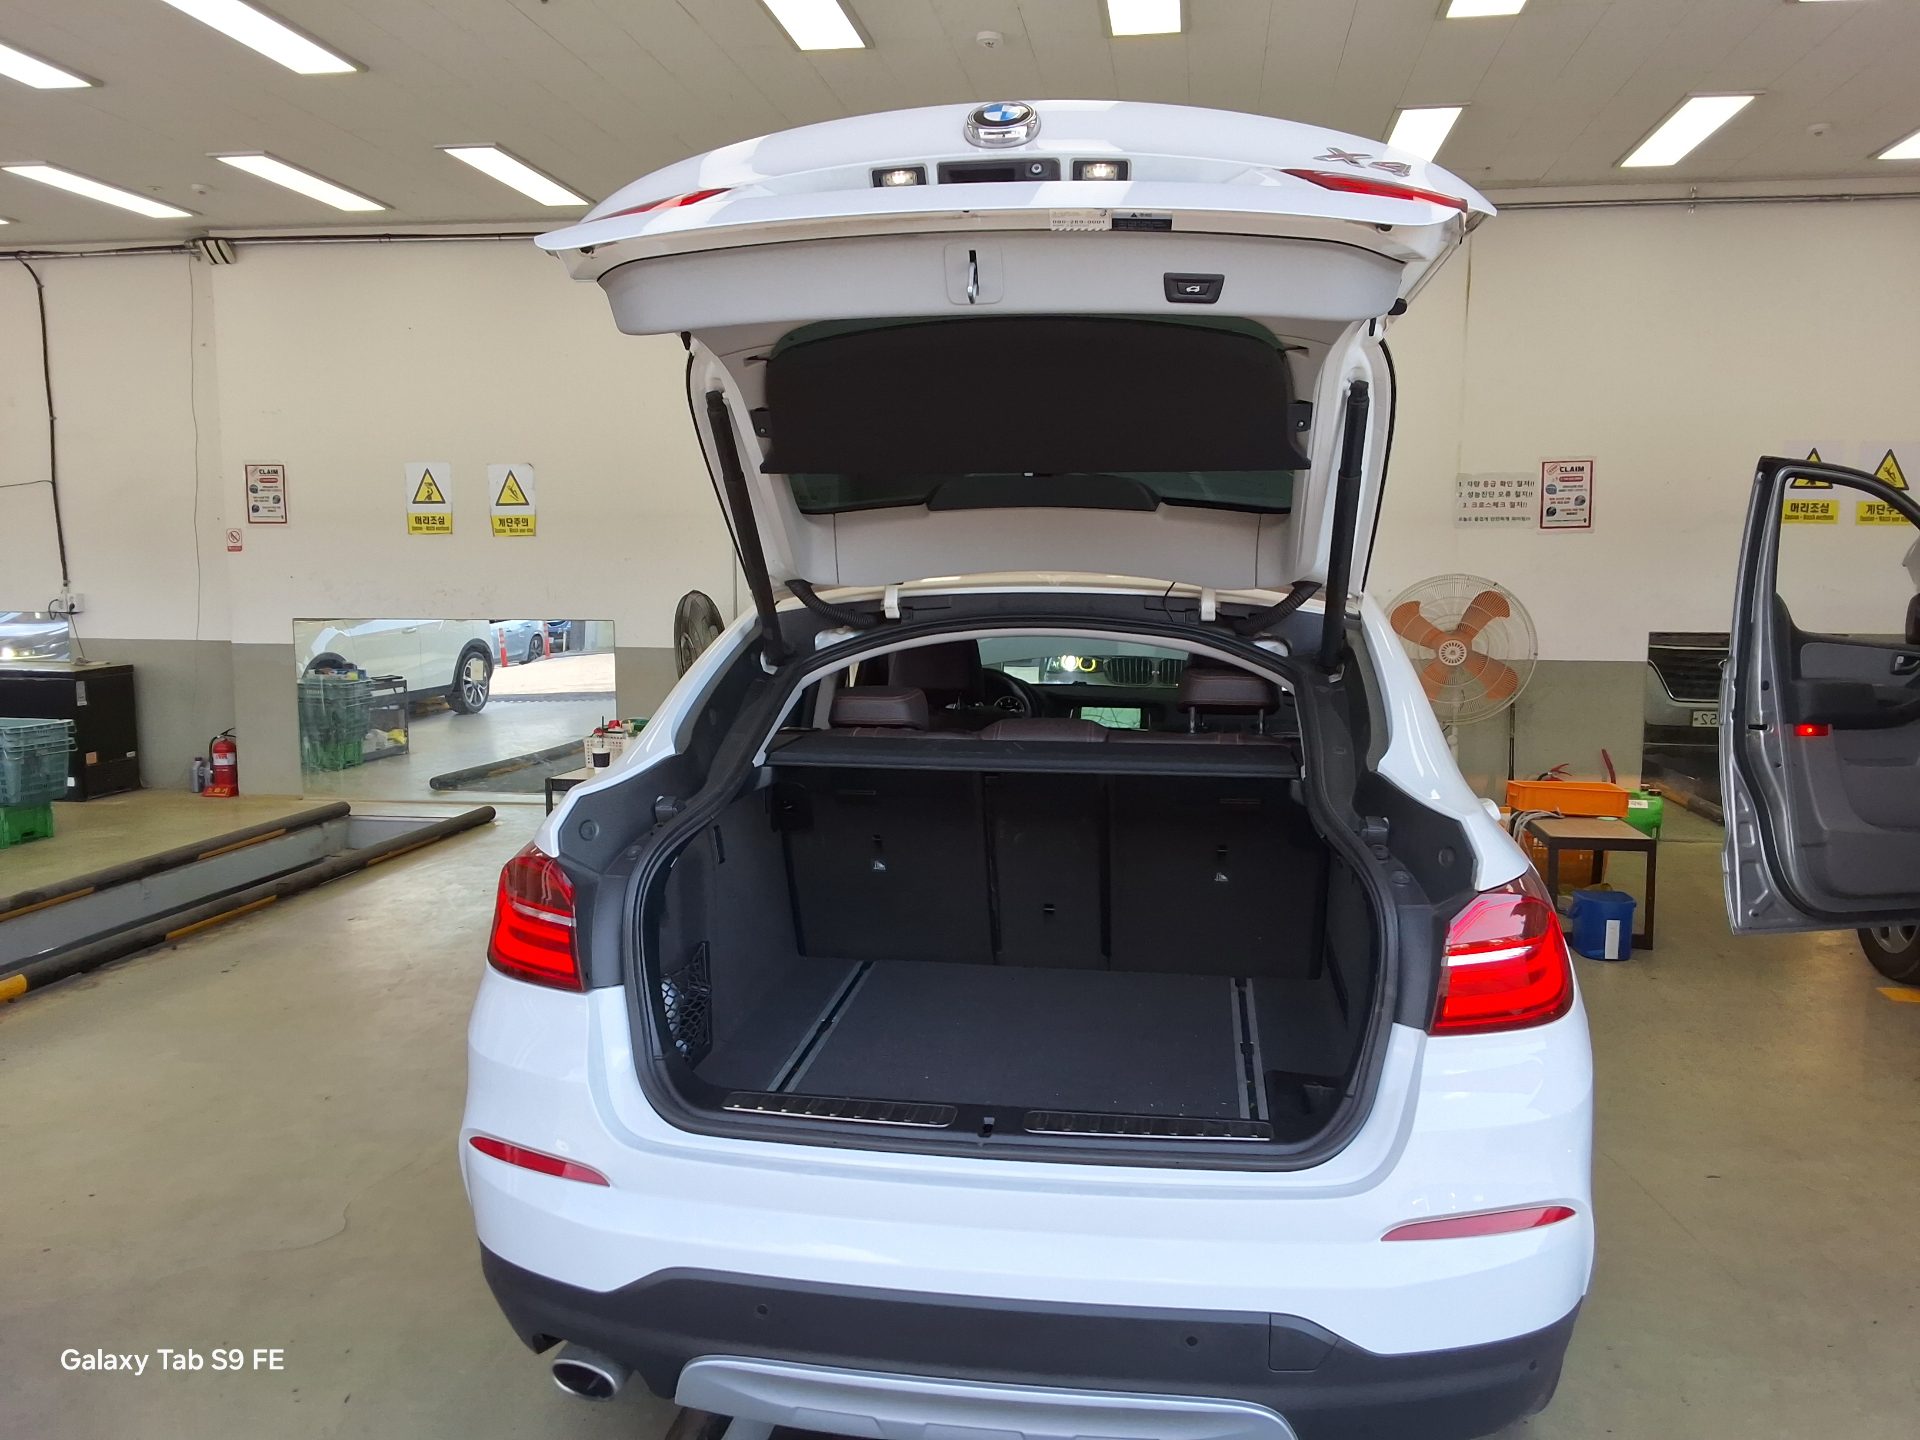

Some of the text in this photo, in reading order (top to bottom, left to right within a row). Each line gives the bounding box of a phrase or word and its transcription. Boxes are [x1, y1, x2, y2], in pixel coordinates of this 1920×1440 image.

[1312, 147, 1412, 177] X4
[1559, 465, 1585, 473] CLAIM
[1790, 502, 1830, 513] 머리조심
[1866, 504, 1901, 515] 계단주
[414, 516, 445, 525] 머리조심
[498, 518, 529, 527] 계단주의
